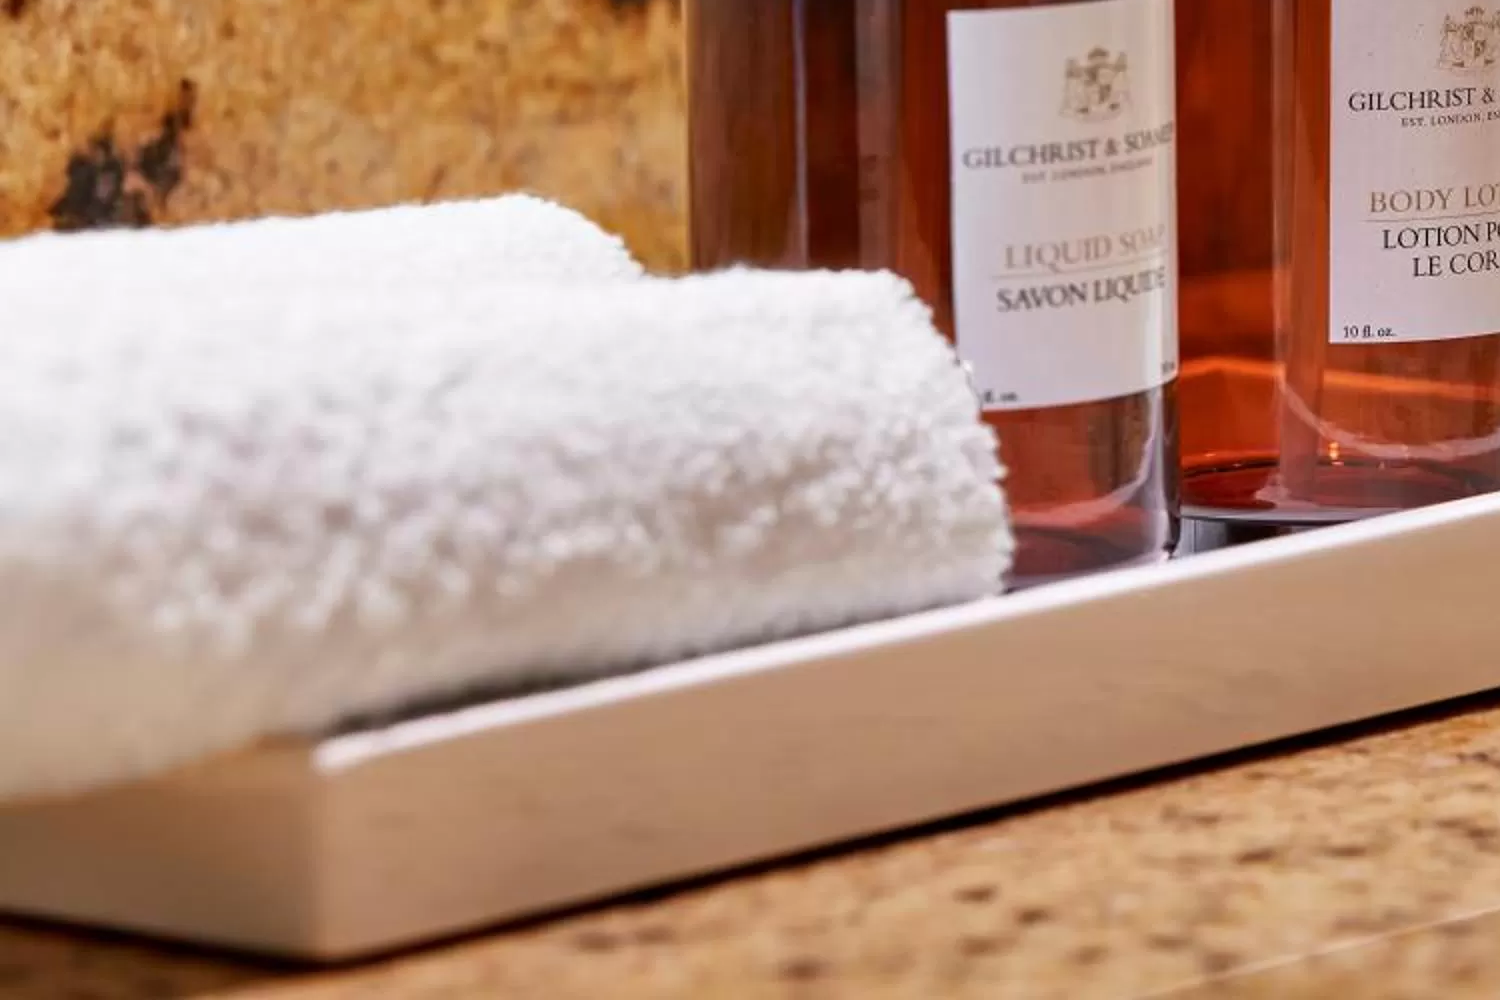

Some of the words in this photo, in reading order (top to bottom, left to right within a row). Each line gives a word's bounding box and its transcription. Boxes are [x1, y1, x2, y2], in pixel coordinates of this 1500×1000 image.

[1348, 87, 1477, 112] GILCHRIST
[1481, 86, 1495, 105] &
[962, 138, 1100, 169] GILCHRIST
[1105, 136, 1119, 157] &
[1370, 186, 1453, 214] BODY
[1382, 223, 1481, 250] LOTION
[1005, 233, 1113, 274] LIQUID
[1412, 255, 1443, 278] LE
[997, 280, 1088, 313] SAVON
[1343, 325, 1359, 339] 10
